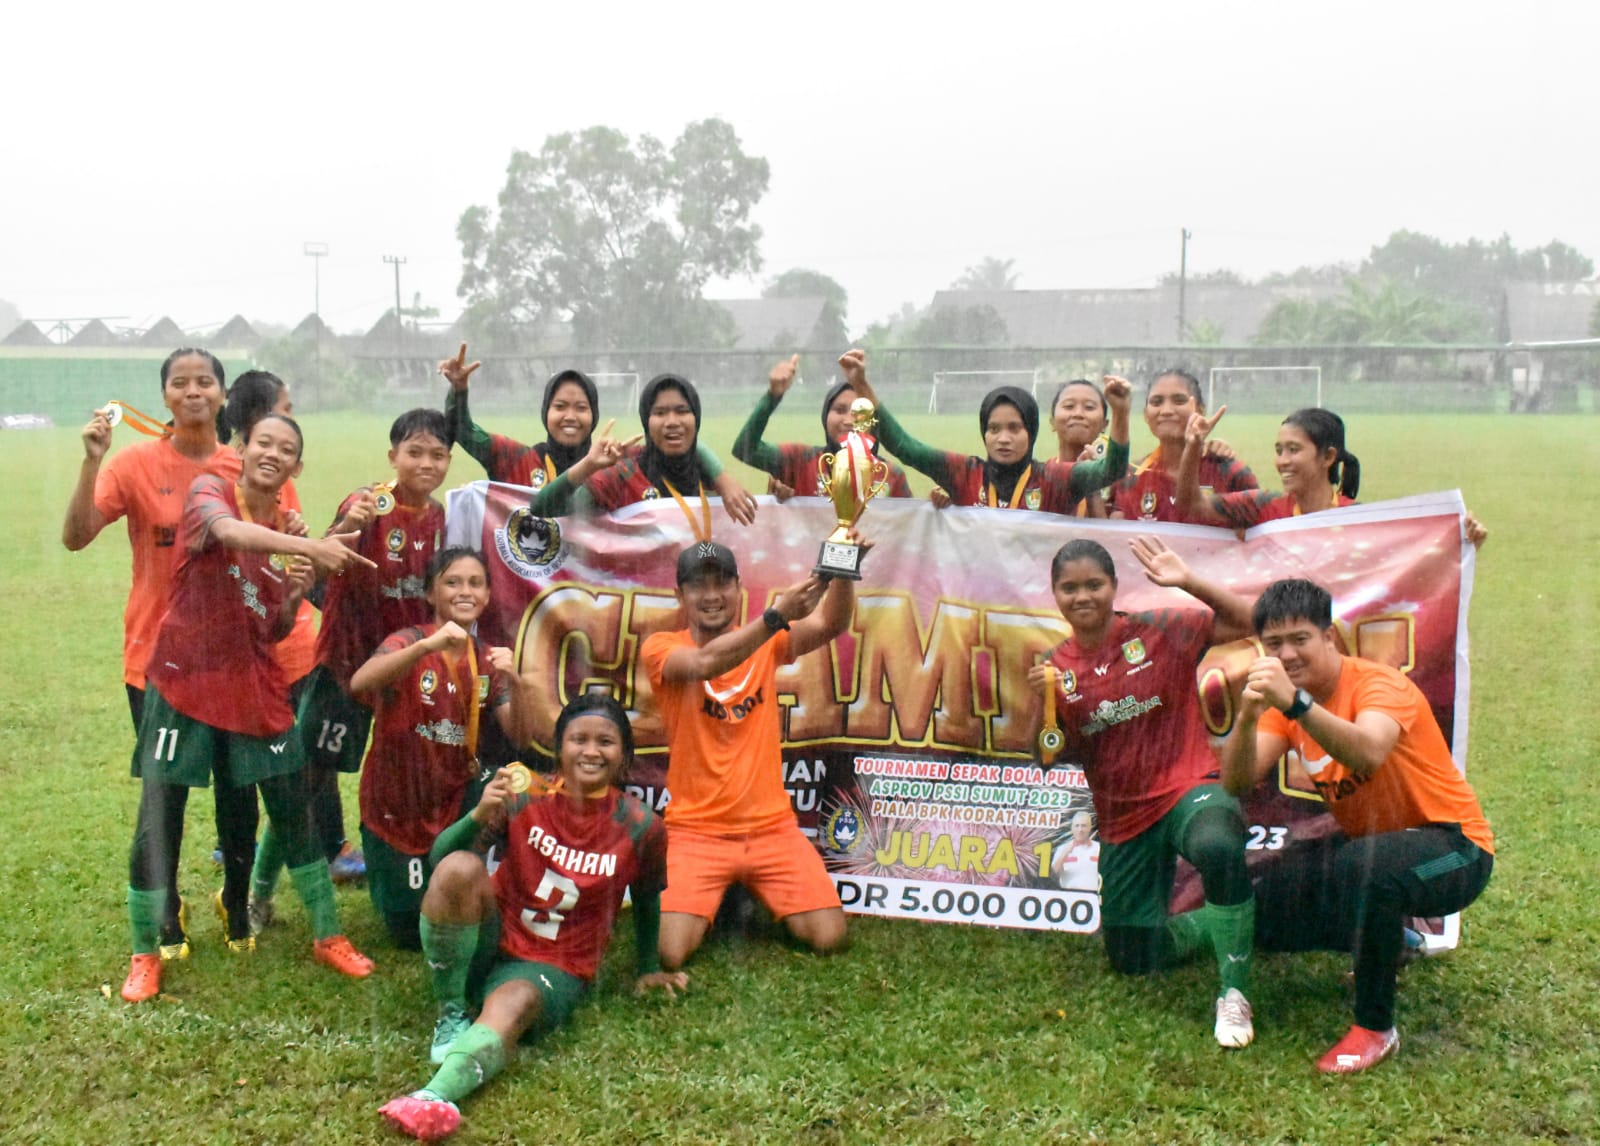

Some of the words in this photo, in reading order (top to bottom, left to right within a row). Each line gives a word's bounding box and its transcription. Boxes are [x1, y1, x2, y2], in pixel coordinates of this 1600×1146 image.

[154, 727, 180, 762] 11
[316, 719, 348, 753] 13
[853, 757, 949, 780] TOURNAMEN
[951, 764, 1000, 783] SEPAK
[1002, 766, 1043, 785] BOLA
[870, 779, 932, 798] ASPROV
[933, 783, 969, 802] PSSI
[971, 786, 1027, 805] SUMUT
[1029, 789, 1071, 808] 2023
[872, 800, 915, 818] PIALA
[918, 803, 950, 820] BPK
[952, 805, 1015, 824] KODRAT
[1016, 809, 1060, 828] SHAH
[527, 825, 617, 877] ASAHAN
[874, 830, 1019, 877] JUARA
[1032, 841, 1054, 878] 1
[408, 857, 424, 889] 8
